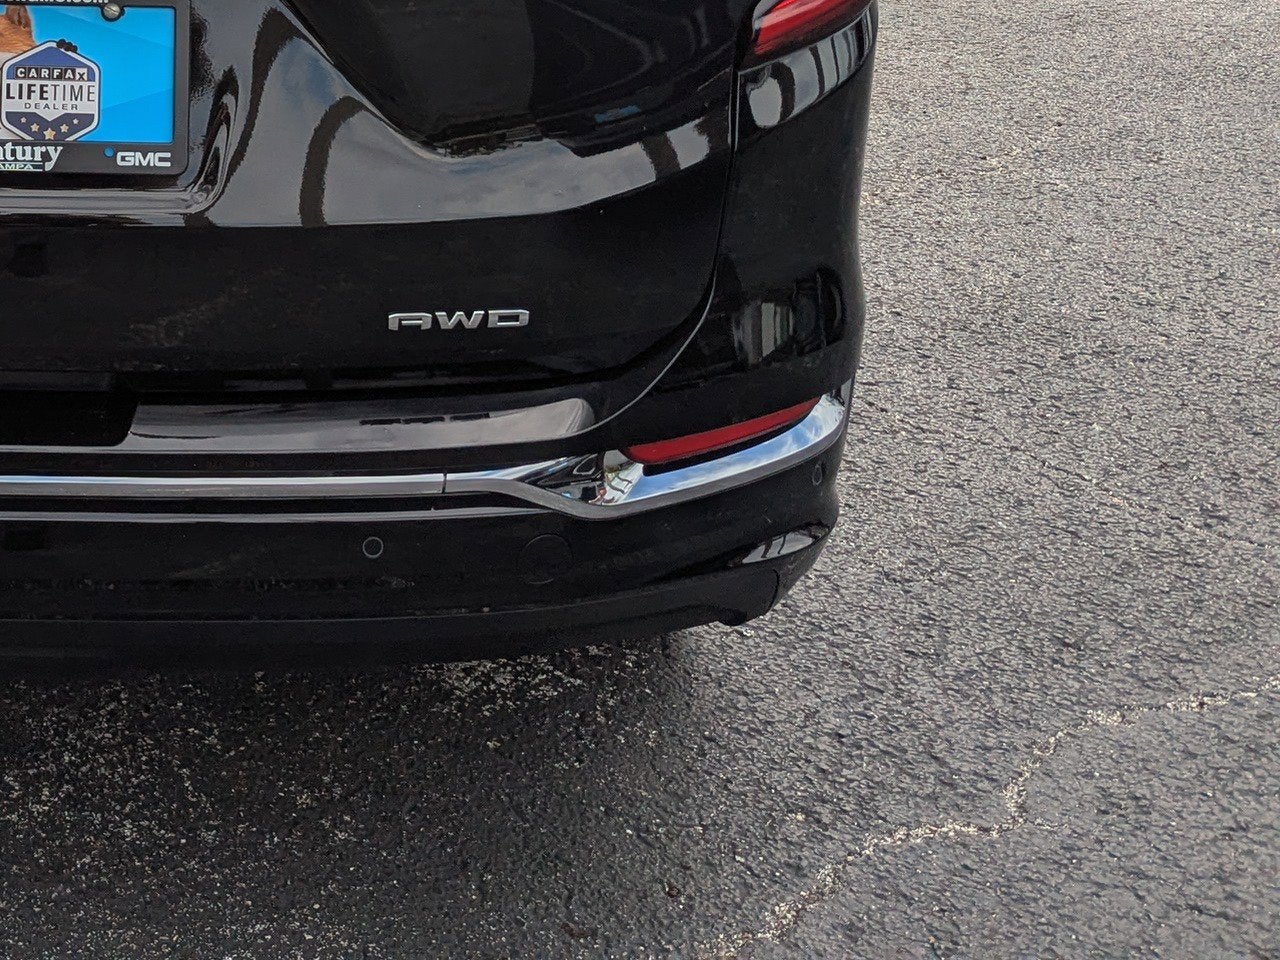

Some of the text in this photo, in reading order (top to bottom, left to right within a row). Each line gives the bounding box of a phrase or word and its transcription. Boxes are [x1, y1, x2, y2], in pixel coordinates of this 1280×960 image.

[16, 67, 88, 81] CARFAX
[5, 83, 96, 102] LIFETIME
[24, 102, 79, 111] DEALER
[116, 151, 172, 167] GMC
[388, 309, 530, 331] AWD
